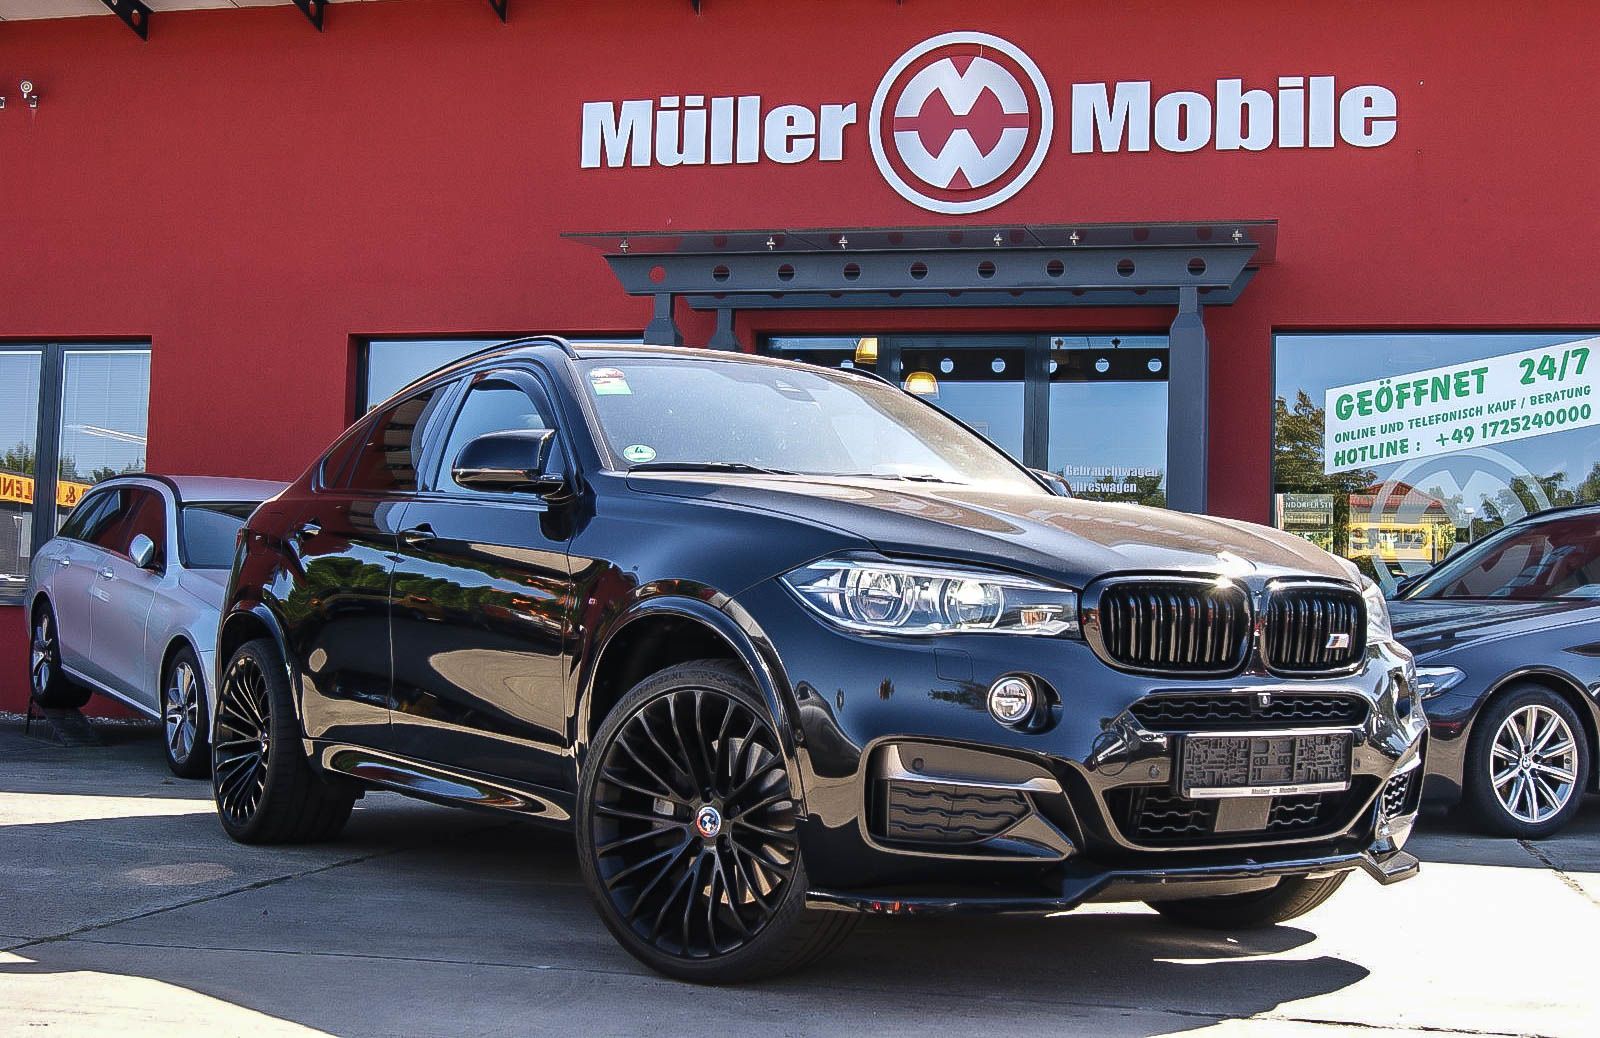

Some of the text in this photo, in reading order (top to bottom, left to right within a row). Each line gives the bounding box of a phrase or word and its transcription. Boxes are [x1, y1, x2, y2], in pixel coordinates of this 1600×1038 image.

[581, 95, 857, 168] Müller
[1071, 75, 1397, 154] Mobile
[1334, 426, 1376, 443] ONLINE
[1380, 421, 1404, 435] UND
[1408, 406, 1483, 429] TELEFONISCH
[1487, 399, 1517, 414] KAUF
[1530, 385, 1591, 406] BERATUNG
[1335, 347, 1590, 421] GEÖFFNET 24/7
[1334, 438, 1409, 467] HOTLINE
[1435, 426, 1475, 447] +49
[1481, 403, 1592, 438] 1725240000
[1071, 481, 1137, 493] ahreswagen
